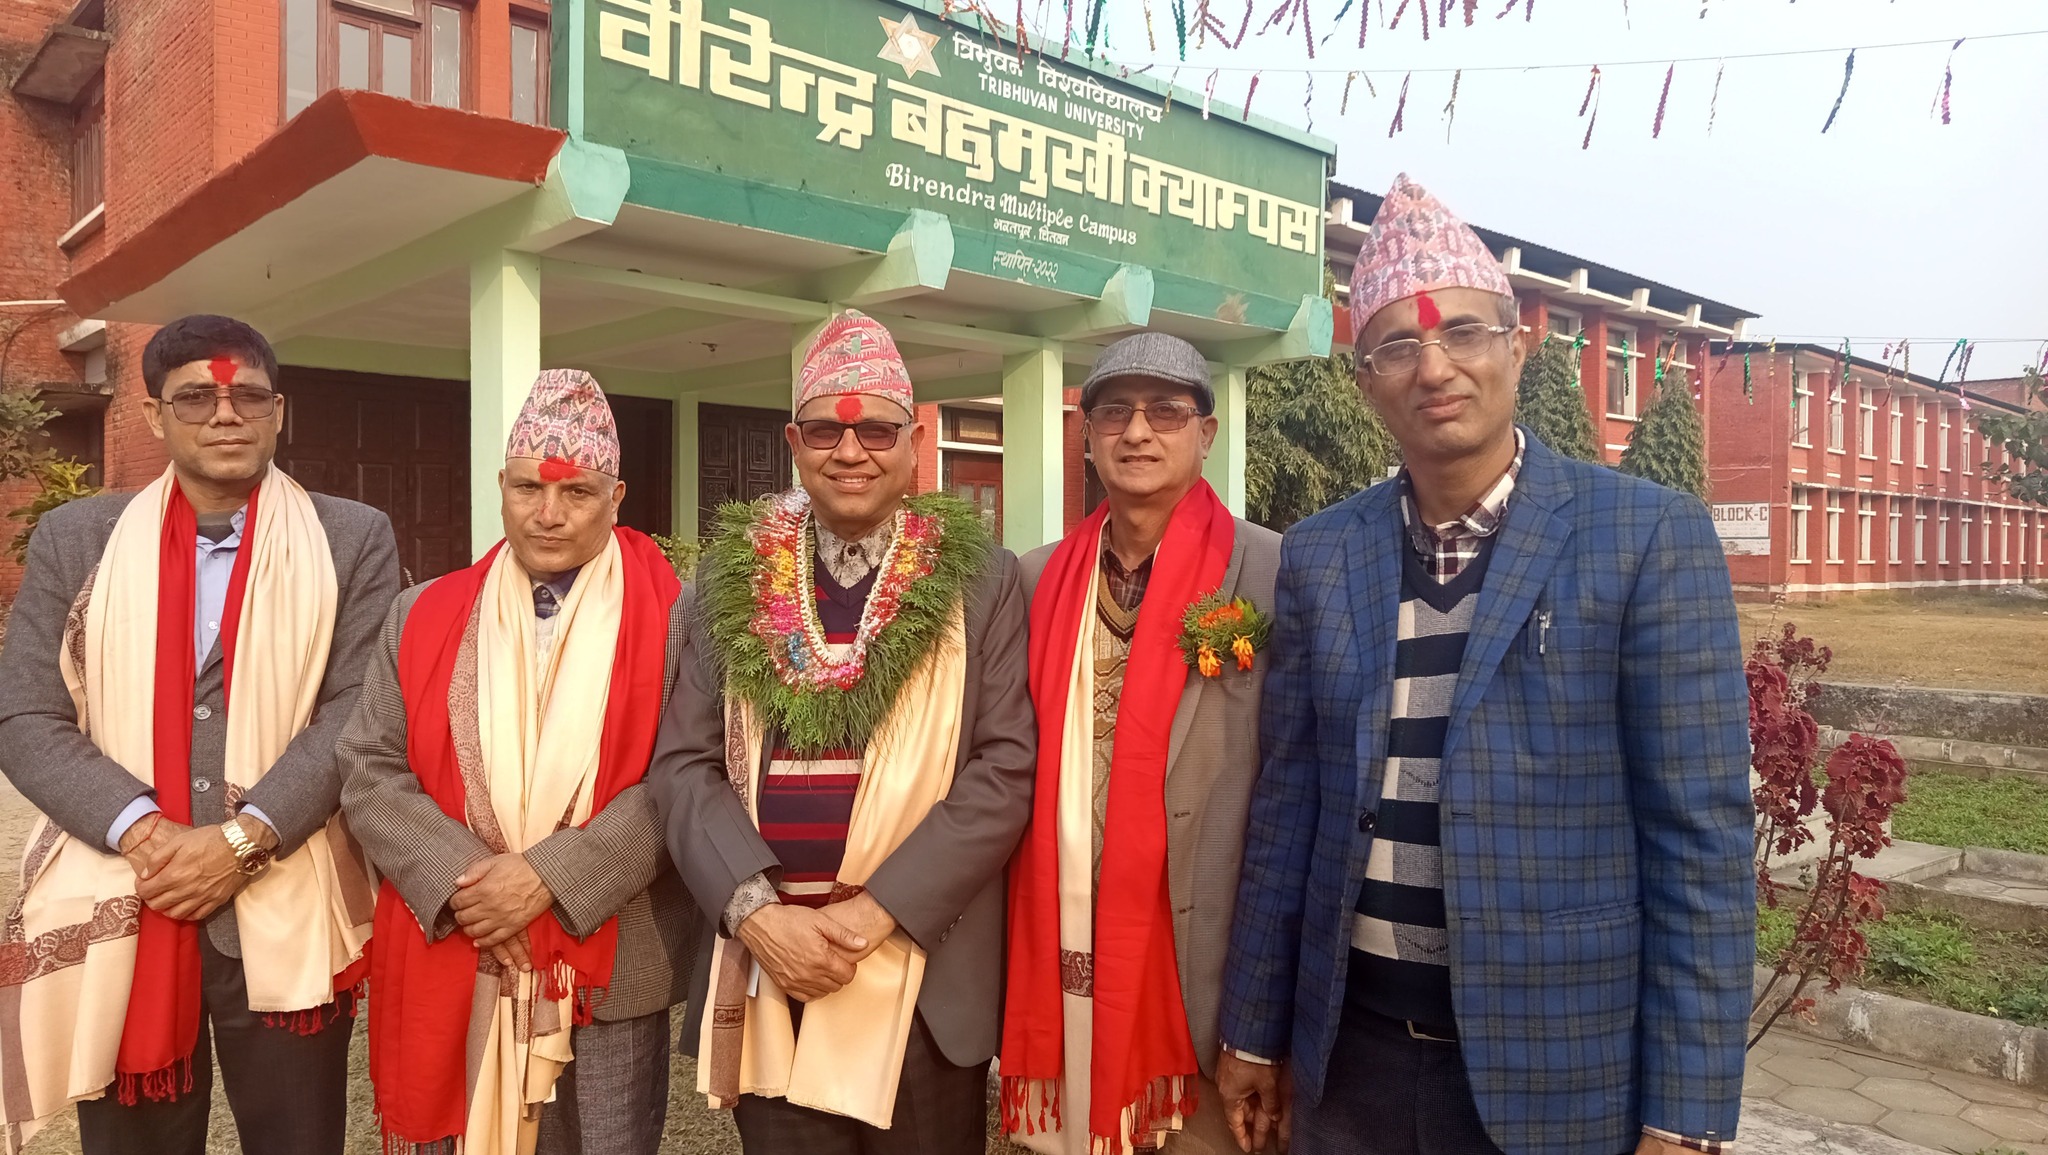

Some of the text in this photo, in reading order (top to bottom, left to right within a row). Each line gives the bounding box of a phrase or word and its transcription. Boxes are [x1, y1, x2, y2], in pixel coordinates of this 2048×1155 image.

[953, 31, 1163, 124] त्रिभुवन विश्वविद्यालय
[978, 72, 1145, 141] TRIBHUVAN UNIVERSITY
[885, 162, 1137, 245] Birendra Multiple Campus
[887, 78, 1127, 206] बहुमुखी
[1129, 153, 1320, 255] क्याम्पस
[1713, 506, 1767, 522] BLOCK-C
